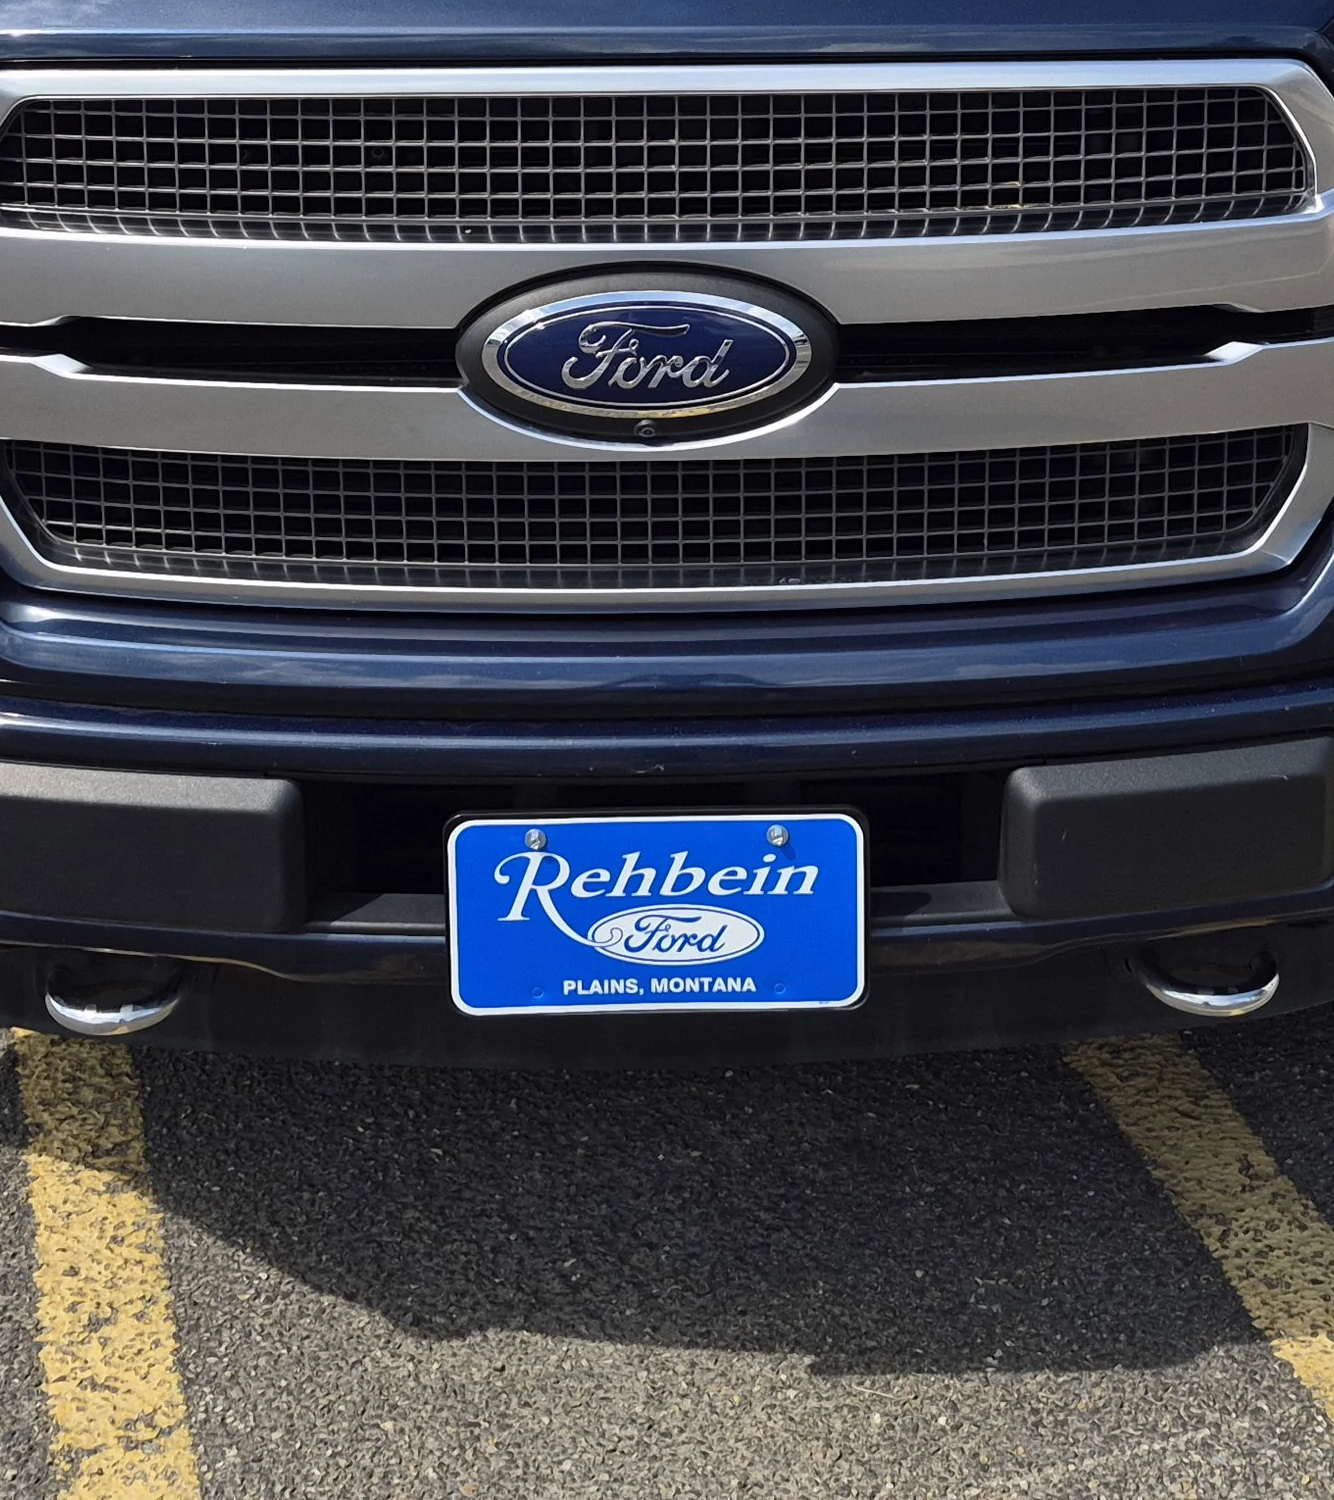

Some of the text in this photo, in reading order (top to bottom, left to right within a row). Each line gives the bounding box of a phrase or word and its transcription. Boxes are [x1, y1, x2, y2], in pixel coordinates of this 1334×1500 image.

[561, 321, 735, 390] Ford
[493, 851, 819, 947] Rehbein
[624, 914, 727, 954] Ford
[563, 977, 757, 997] PLAINS, MONTANA
